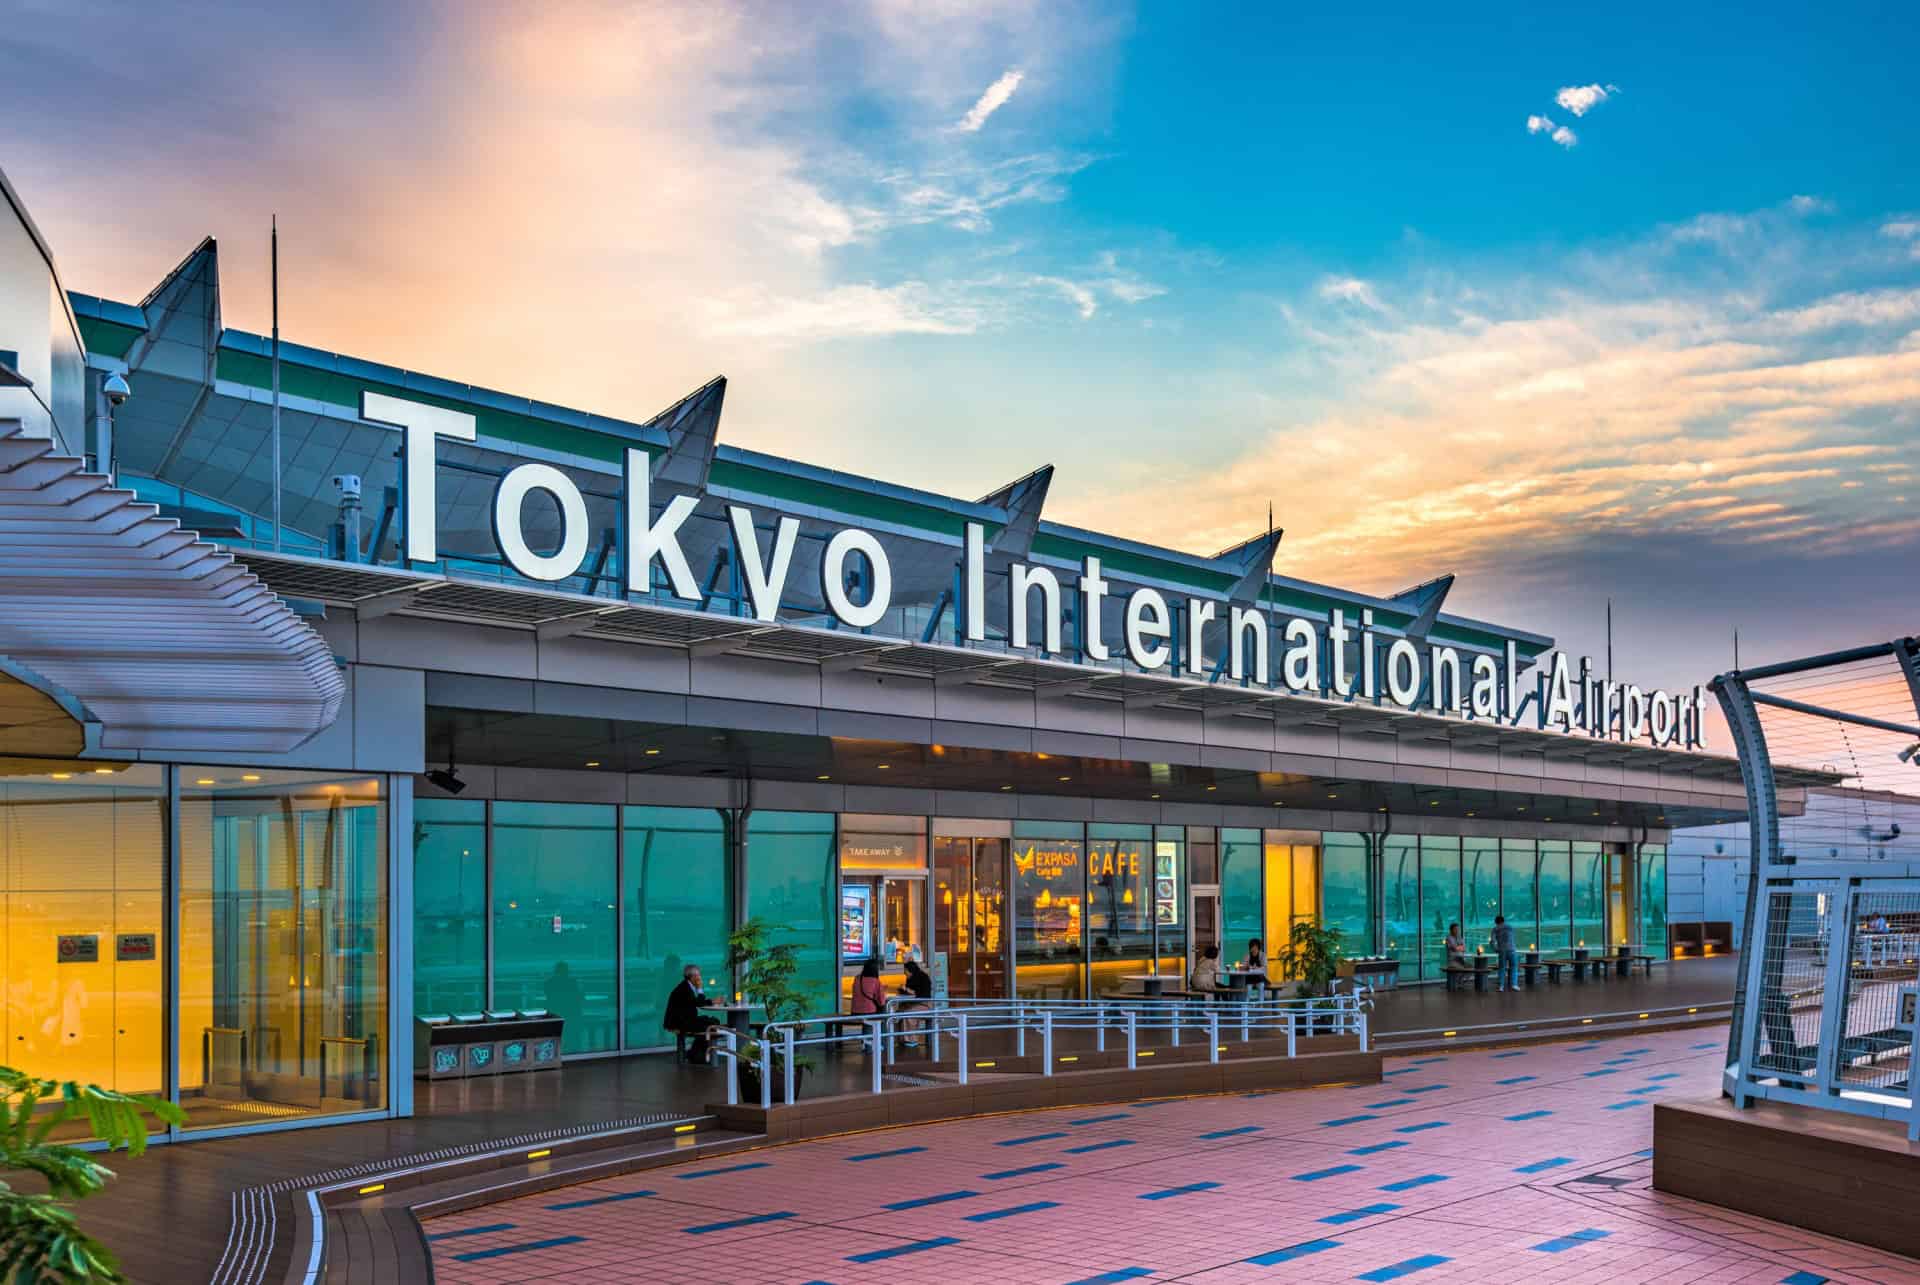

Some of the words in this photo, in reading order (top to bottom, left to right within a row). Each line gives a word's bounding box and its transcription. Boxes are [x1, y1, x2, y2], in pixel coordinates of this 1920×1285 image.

[360, 389, 892, 628] Tokyo
[963, 521, 1517, 719] International
[1546, 650, 1708, 749] Airport
[1036, 852, 1077, 866] EXPASA
[1089, 852, 1138, 875] CAFE
